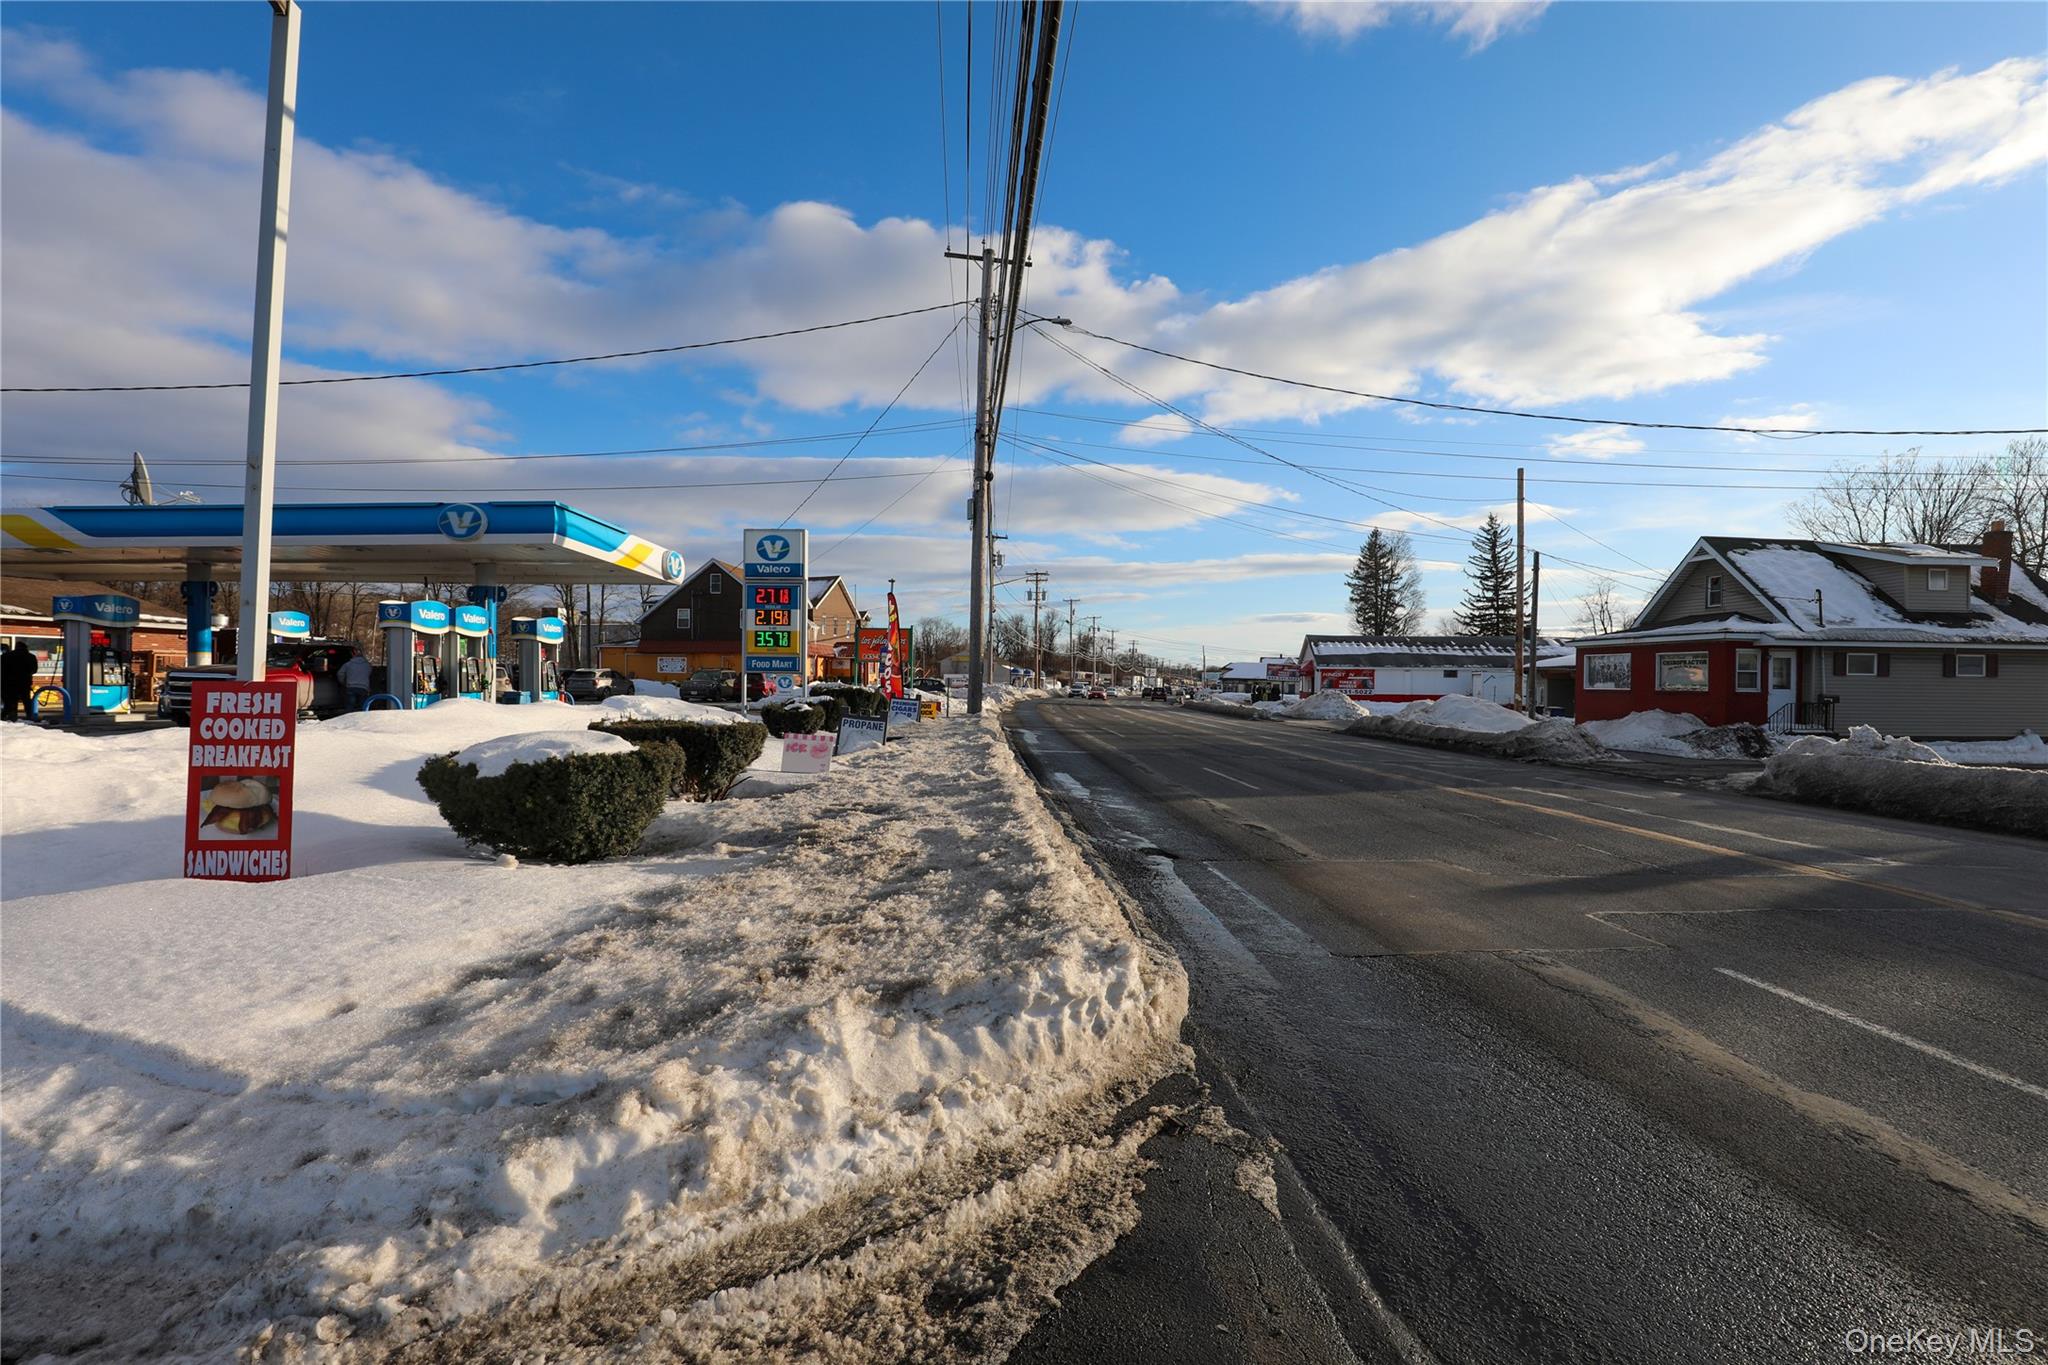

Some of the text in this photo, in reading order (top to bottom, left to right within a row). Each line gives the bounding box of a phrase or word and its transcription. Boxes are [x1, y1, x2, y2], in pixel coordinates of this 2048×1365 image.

[756, 564, 791, 574] Valero
[94, 601, 134, 615] Valero
[419, 608, 446, 621] Valero
[279, 617, 306, 627] Valero
[463, 613, 487, 625] Valero
[543, 623, 562, 633] Valero
[771, 660, 793, 668] MART
[206, 692, 282, 715] FRESH
[200, 717, 286, 740] COOKED
[842, 718, 884, 732] PROPANE
[191, 745, 291, 768] BREAKFAST
[187, 849, 288, 877] SANDWICHES
